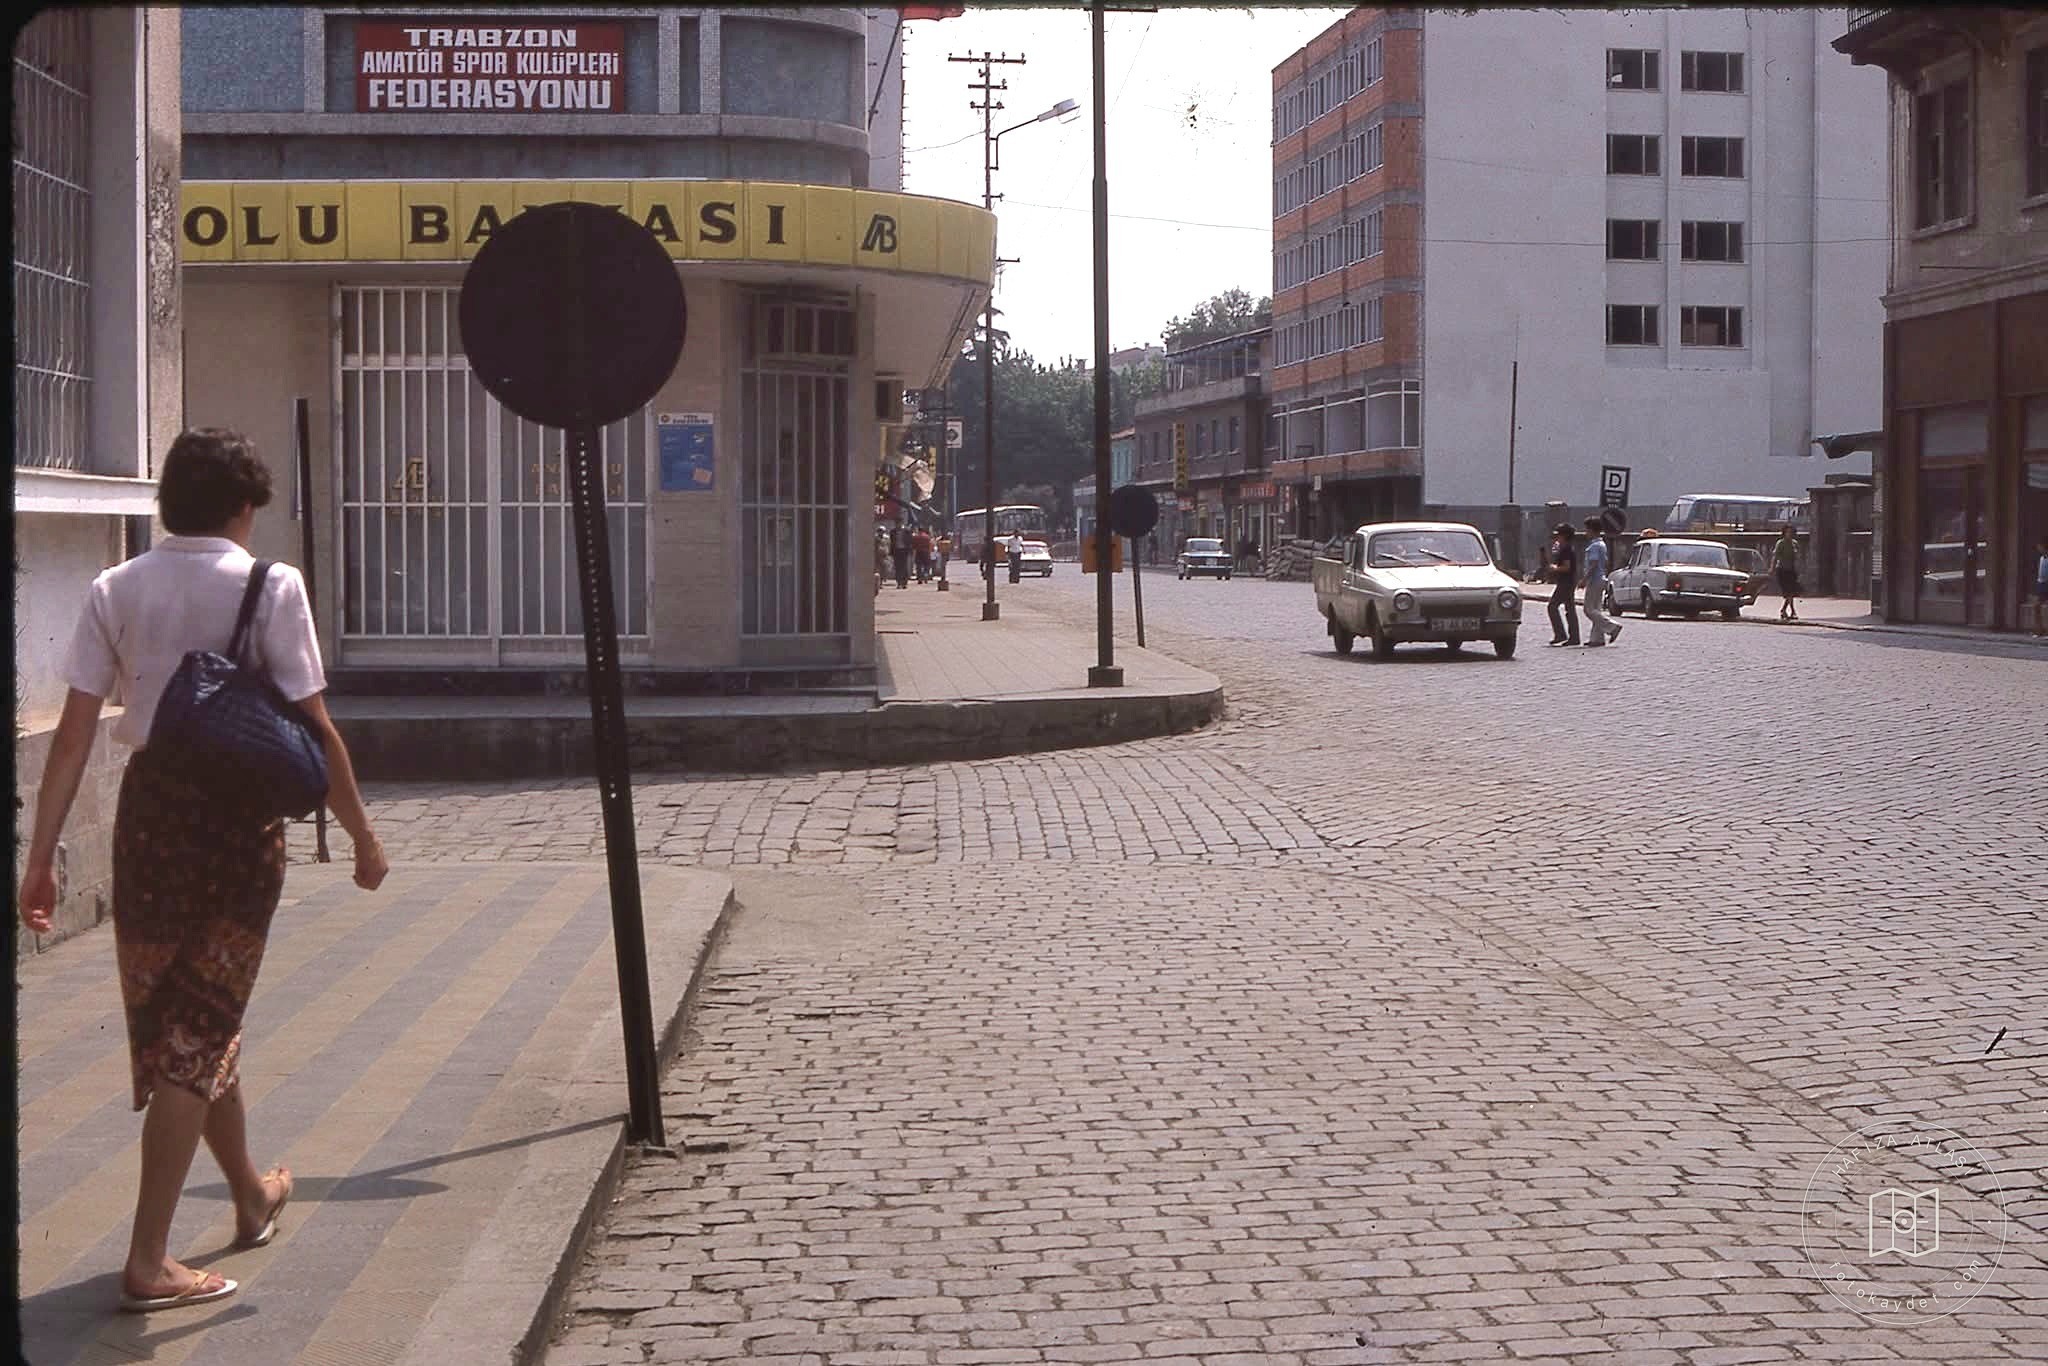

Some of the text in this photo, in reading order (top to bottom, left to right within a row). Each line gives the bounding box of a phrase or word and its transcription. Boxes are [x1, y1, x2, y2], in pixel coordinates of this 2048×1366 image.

[403, 28, 577, 47] TRABZON
[362, 49, 443, 74] AMATÖR
[453, 52, 508, 75] SPOR
[369, 79, 611, 109] FEDERASYONU
[408, 202, 785, 244] BAASI
[1609, 472, 1622, 488] D
